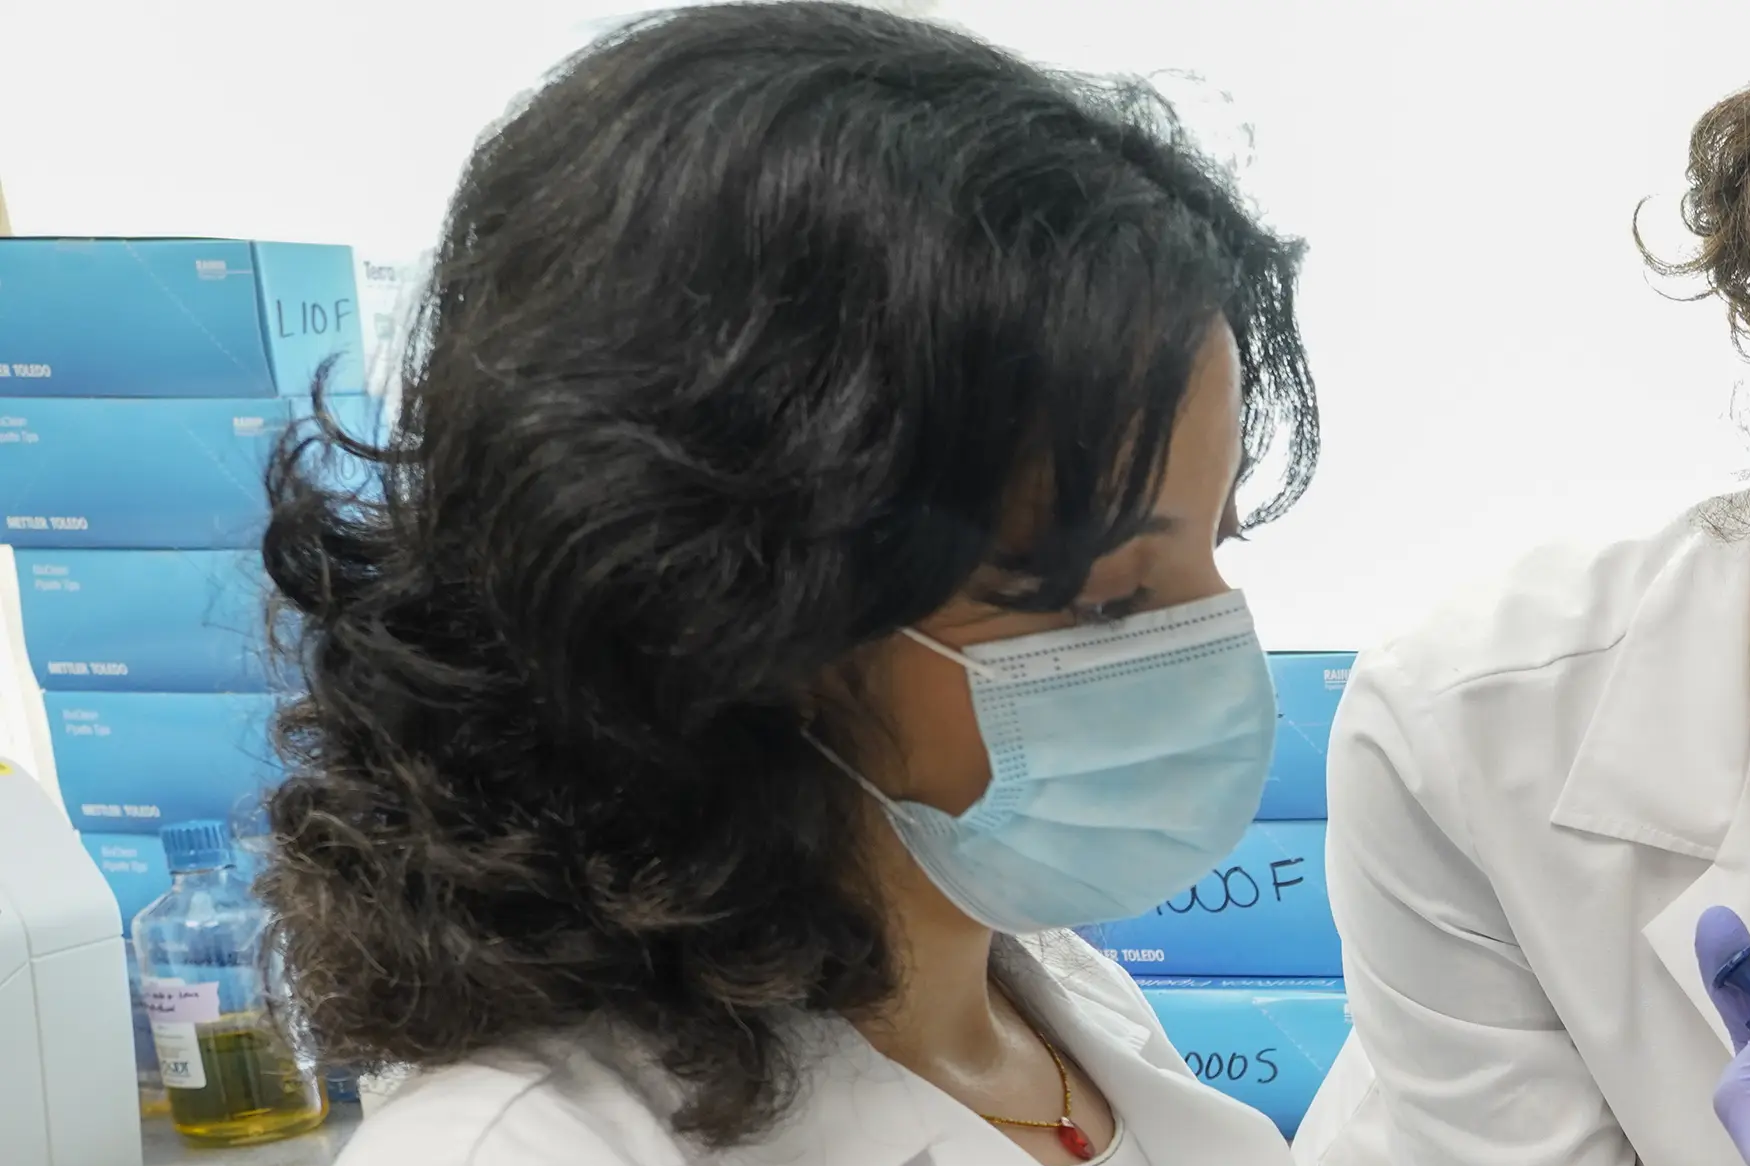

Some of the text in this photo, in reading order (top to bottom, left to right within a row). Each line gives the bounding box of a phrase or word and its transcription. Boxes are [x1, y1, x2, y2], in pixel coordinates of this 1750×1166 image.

[12, 363, 52, 378] TOLEDO
[6, 515, 88, 531] METTLER TOLEDO
[90, 661, 128, 676] TOLEDO
[1121, 949, 1165, 962] TOLEDO
